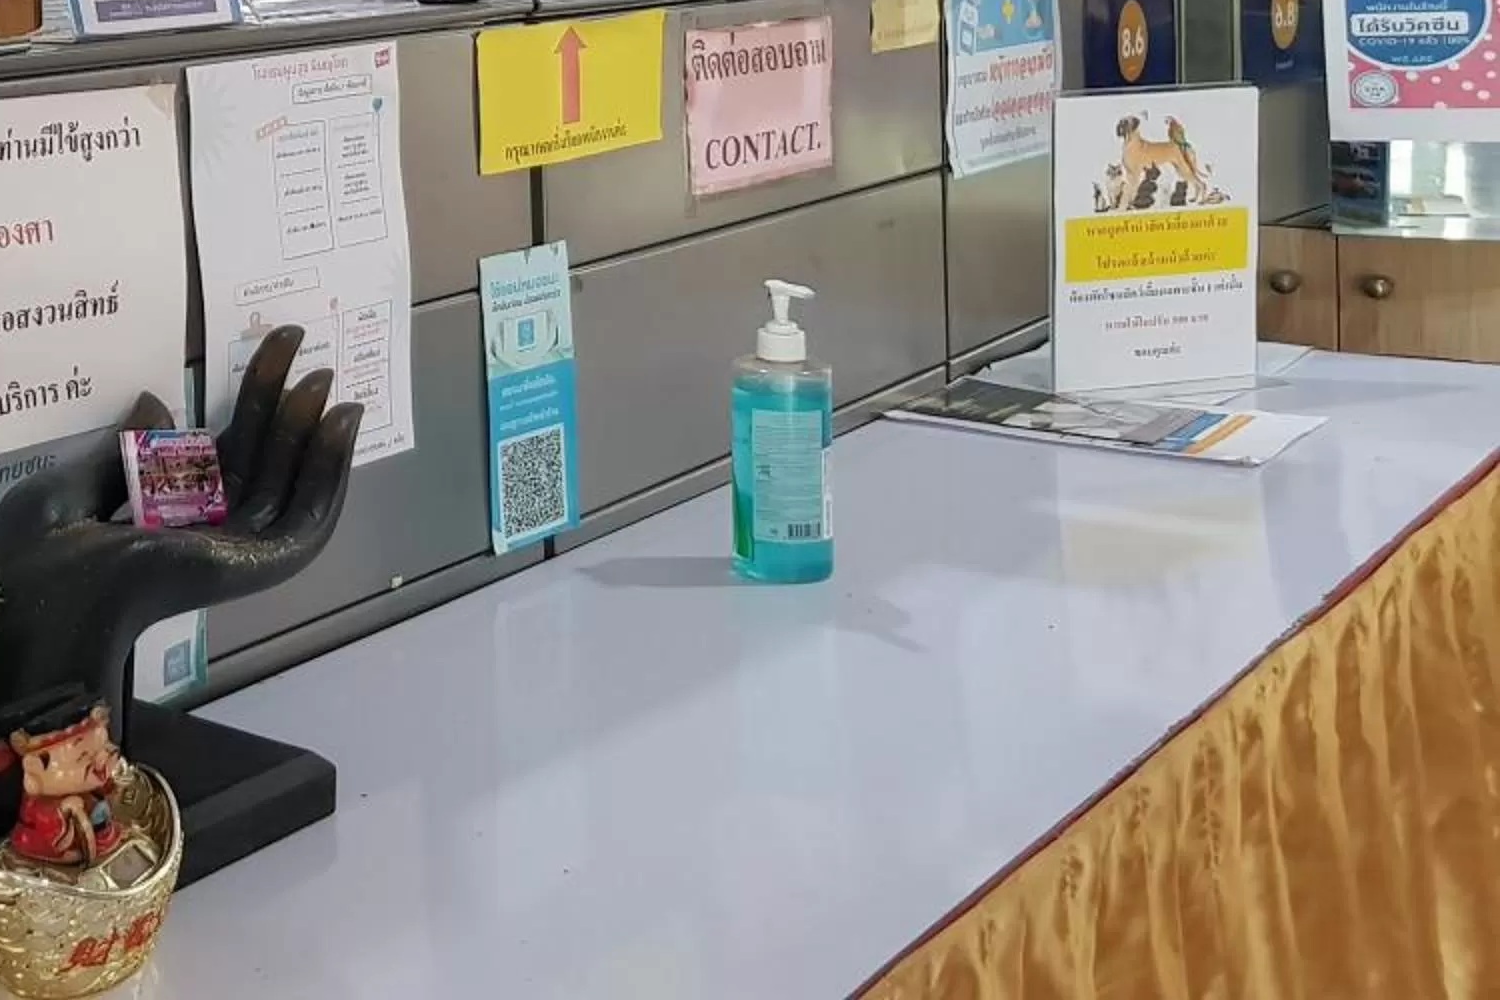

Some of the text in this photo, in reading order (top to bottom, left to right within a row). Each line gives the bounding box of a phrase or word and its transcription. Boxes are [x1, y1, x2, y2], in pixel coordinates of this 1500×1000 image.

[1358, 16, 1461, 35] ได้รับวัคซีน
[690, 31, 827, 82] ติดต่อสอบถาม
[1121, 29, 1145, 58] 8.6
[704, 121, 822, 171] CONTACT.
[65, 366, 94, 401] ค่ะ
